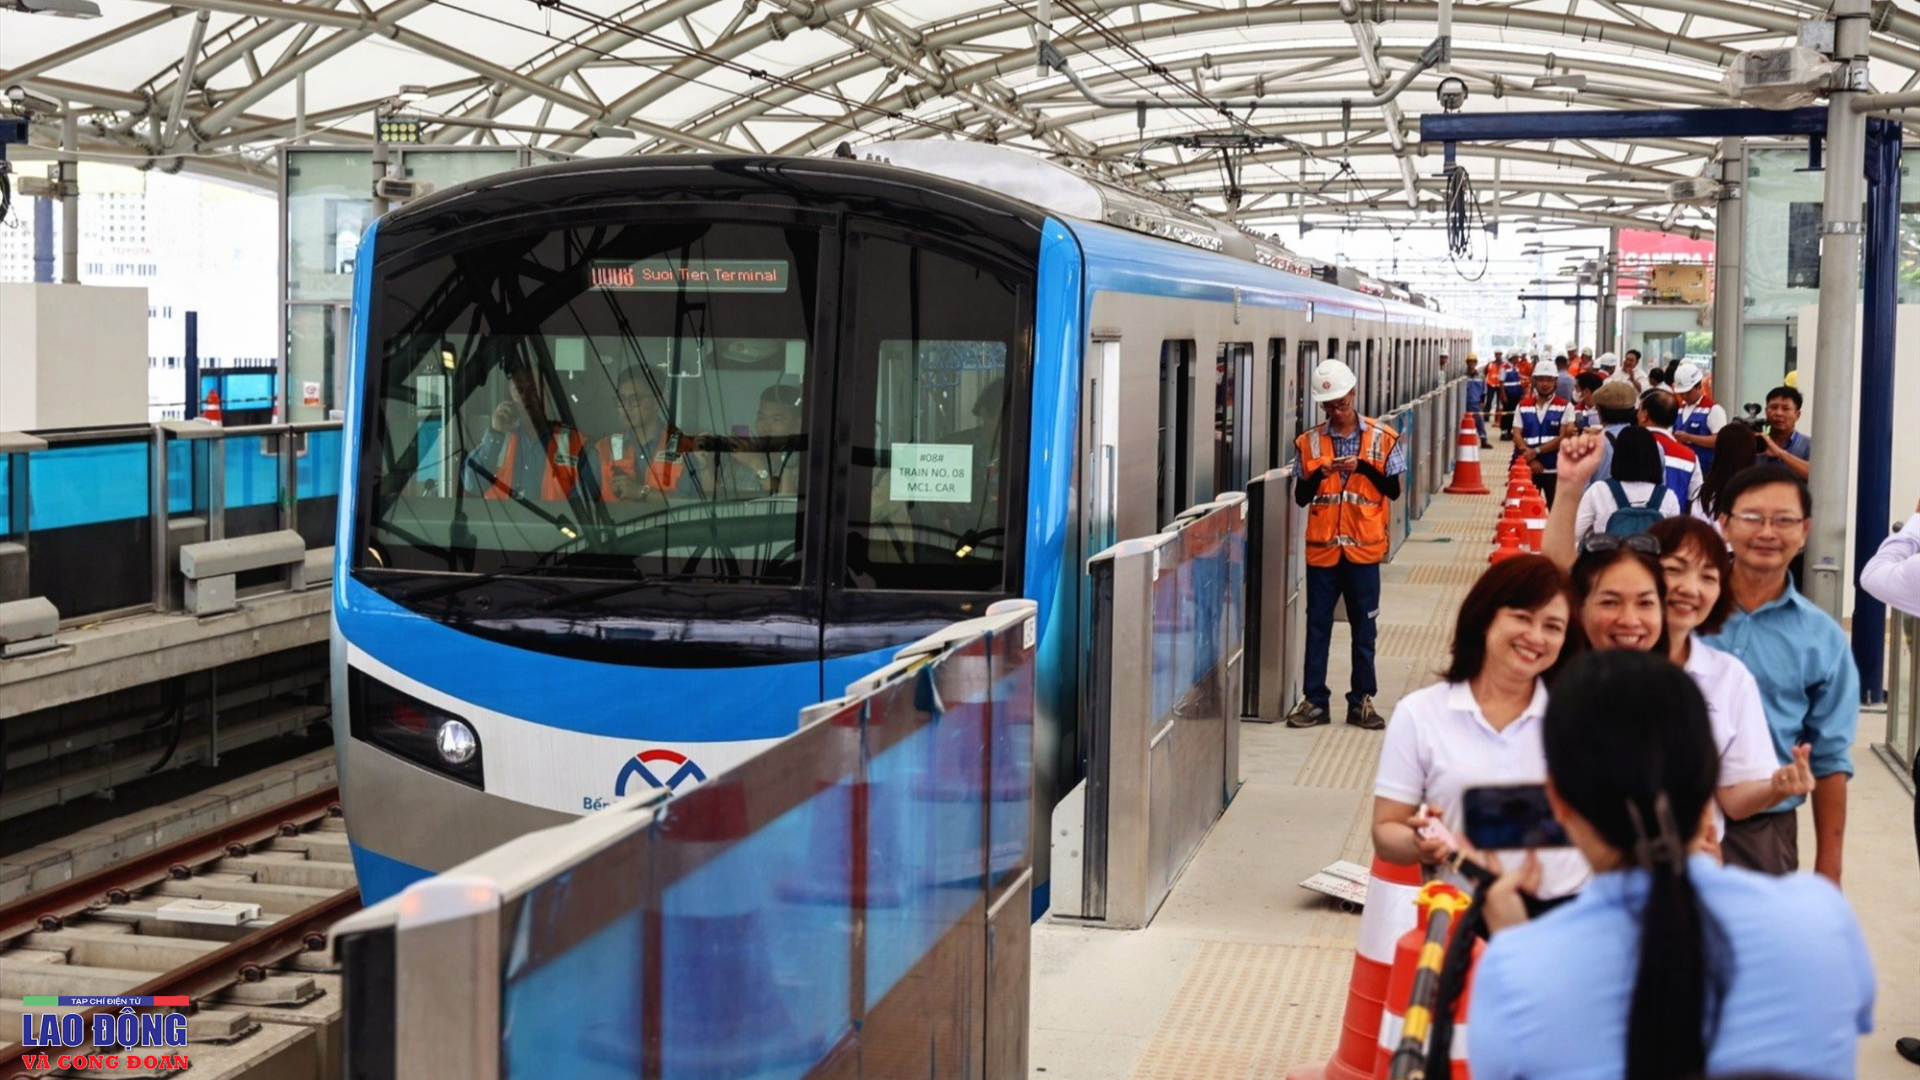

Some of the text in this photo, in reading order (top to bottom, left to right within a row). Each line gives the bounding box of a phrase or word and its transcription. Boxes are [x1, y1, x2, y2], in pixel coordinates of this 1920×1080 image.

[642, 269, 673, 281] Suoi
[679, 268, 710, 281] Tien
[714, 268, 777, 281] Terminal
[920, 453, 944, 463] #08#
[899, 467, 965, 478] TRAIN NO. 08
[907, 483, 956, 492] MC1. CAR
